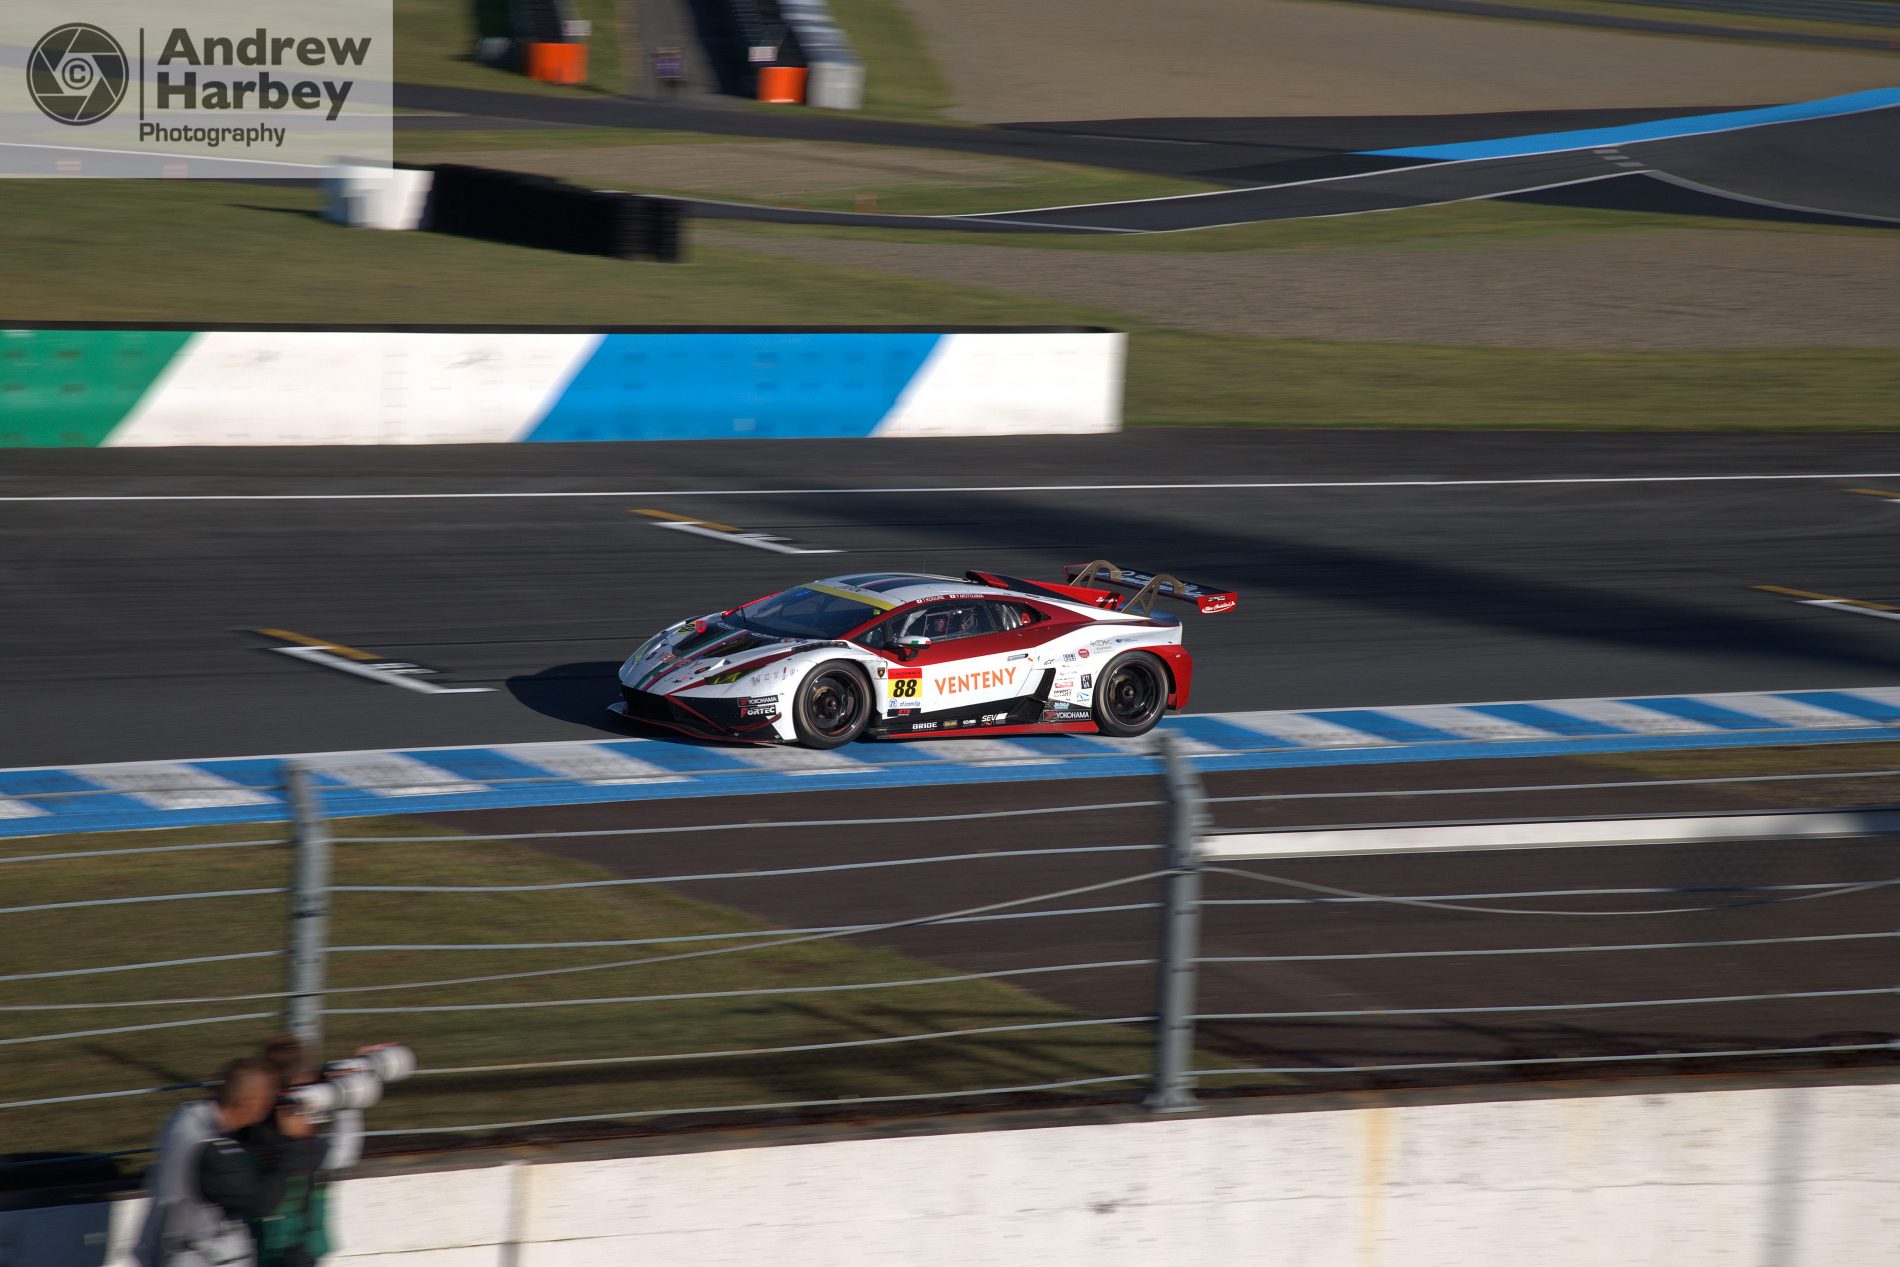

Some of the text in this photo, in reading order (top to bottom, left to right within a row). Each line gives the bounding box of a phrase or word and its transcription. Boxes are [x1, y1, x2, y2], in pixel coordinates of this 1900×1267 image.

[934, 666, 1017, 696] VENTENY
[892, 679, 917, 698] 88
[748, 696, 777, 705] YOKOHAMA
[981, 714, 997, 722] SEV
[1056, 711, 1090, 719] YOKOHAMA
[912, 721, 938, 730] BRIDE
